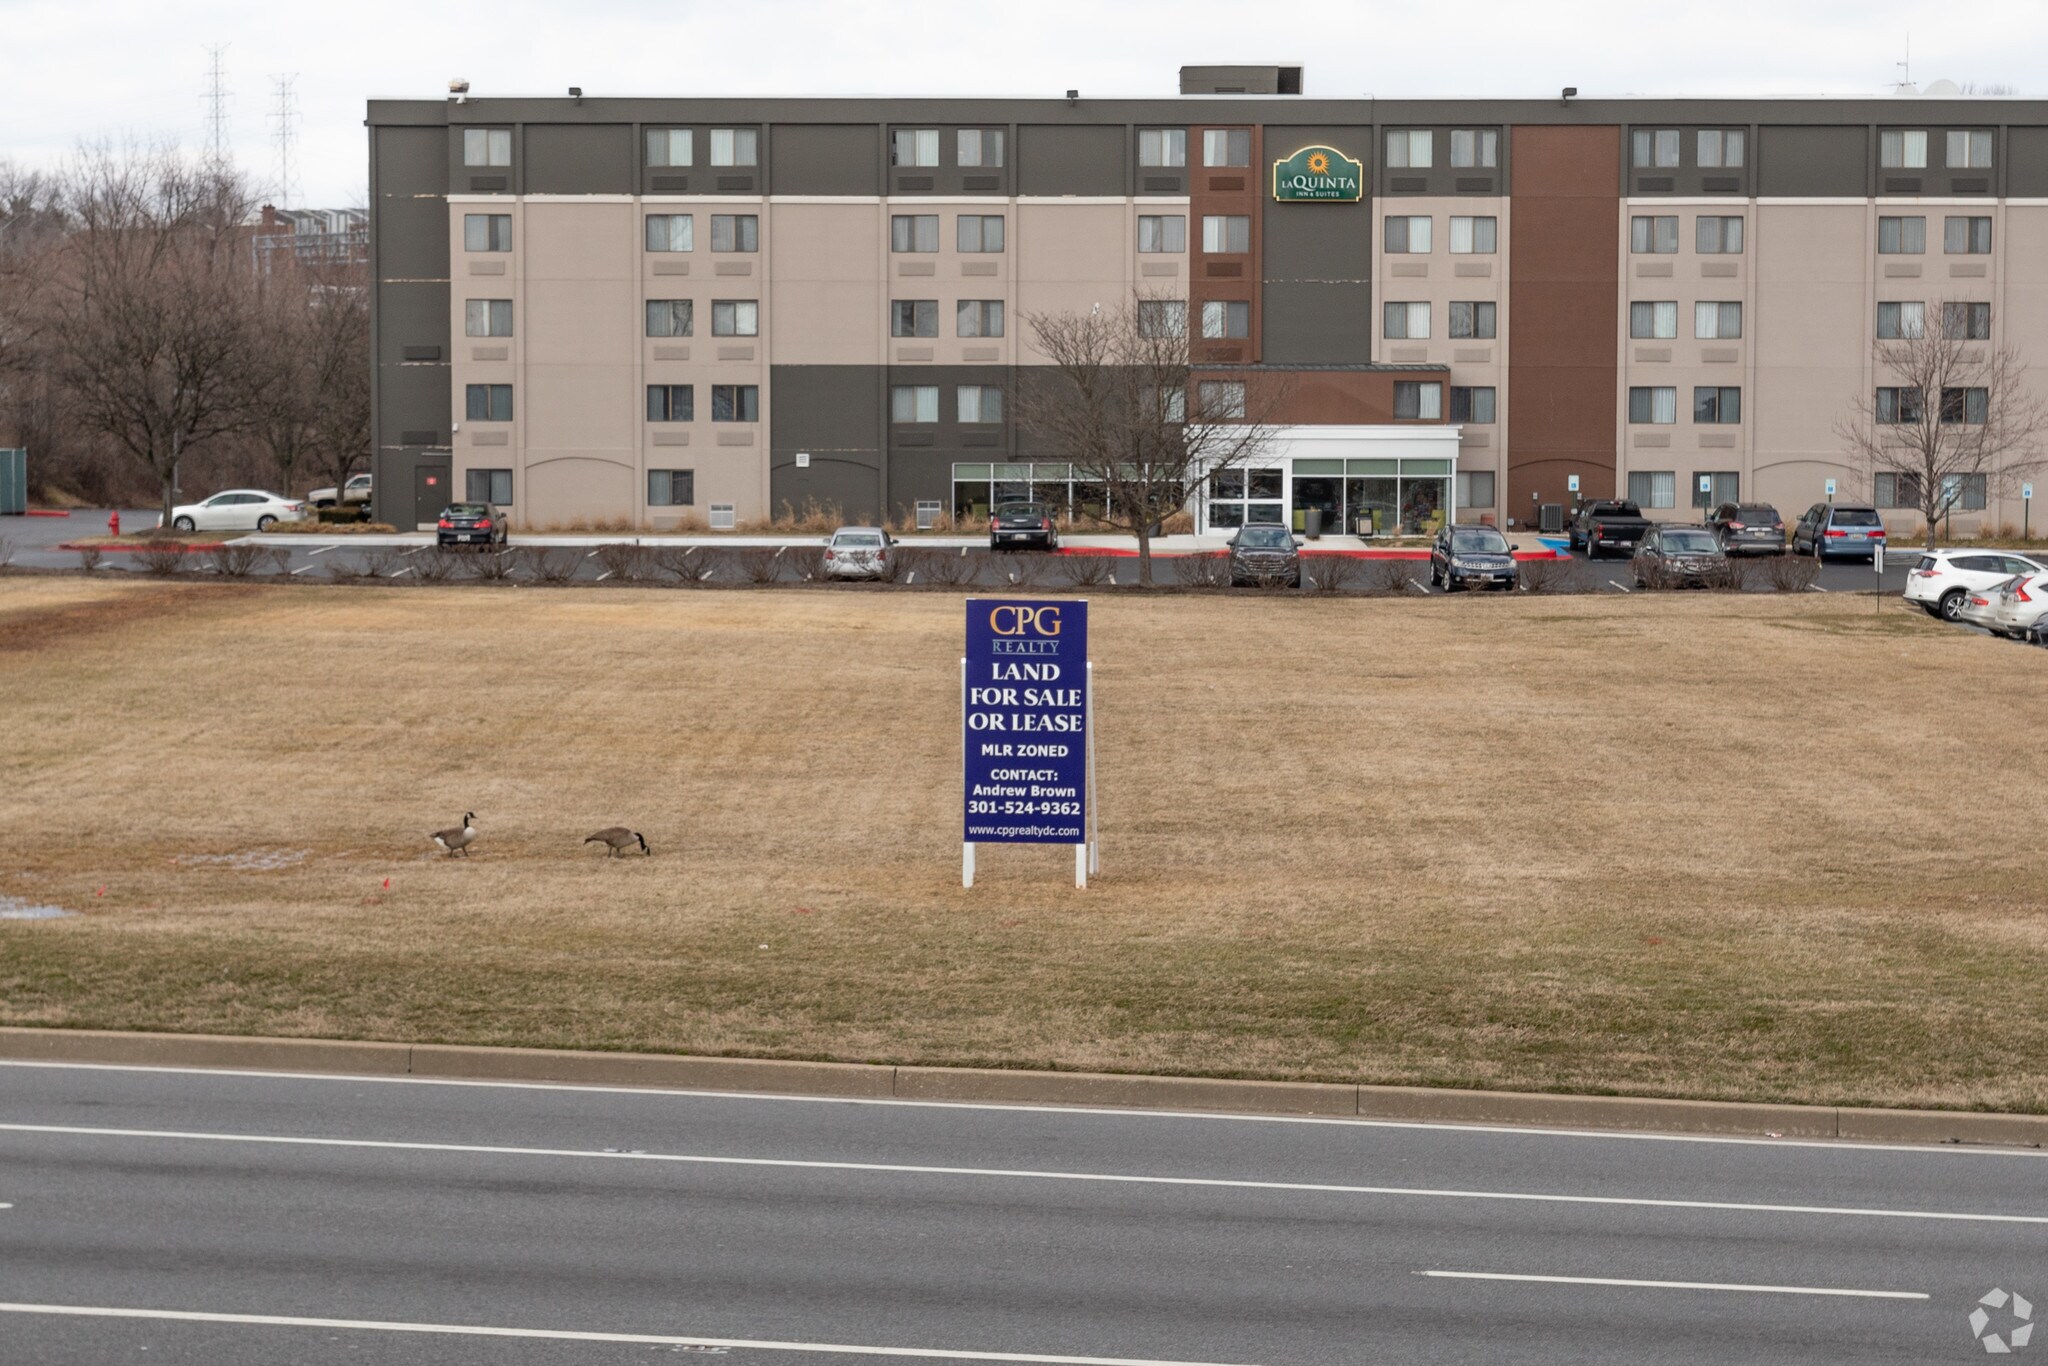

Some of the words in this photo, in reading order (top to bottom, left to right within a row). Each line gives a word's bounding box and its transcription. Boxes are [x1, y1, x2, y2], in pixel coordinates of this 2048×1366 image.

[989, 605, 1062, 636] CPG
[992, 641, 1060, 653] REALTY
[992, 662, 1061, 682] LAND
[970, 687, 1020, 706] FOR
[1023, 687, 1082, 707] SALE
[968, 712, 1007, 731] OR
[1011, 713, 1083, 733] LEASE
[981, 743, 1013, 757] MLR
[1016, 744, 1069, 758] ZONED
[990, 768, 1059, 782] CONTACT:
[972, 783, 1027, 797] Andrew
[1030, 784, 1076, 798] Brown
[968, 800, 1081, 816] 301-524-9362
[968, 824, 1080, 838] www.cpgrealtydc.com
